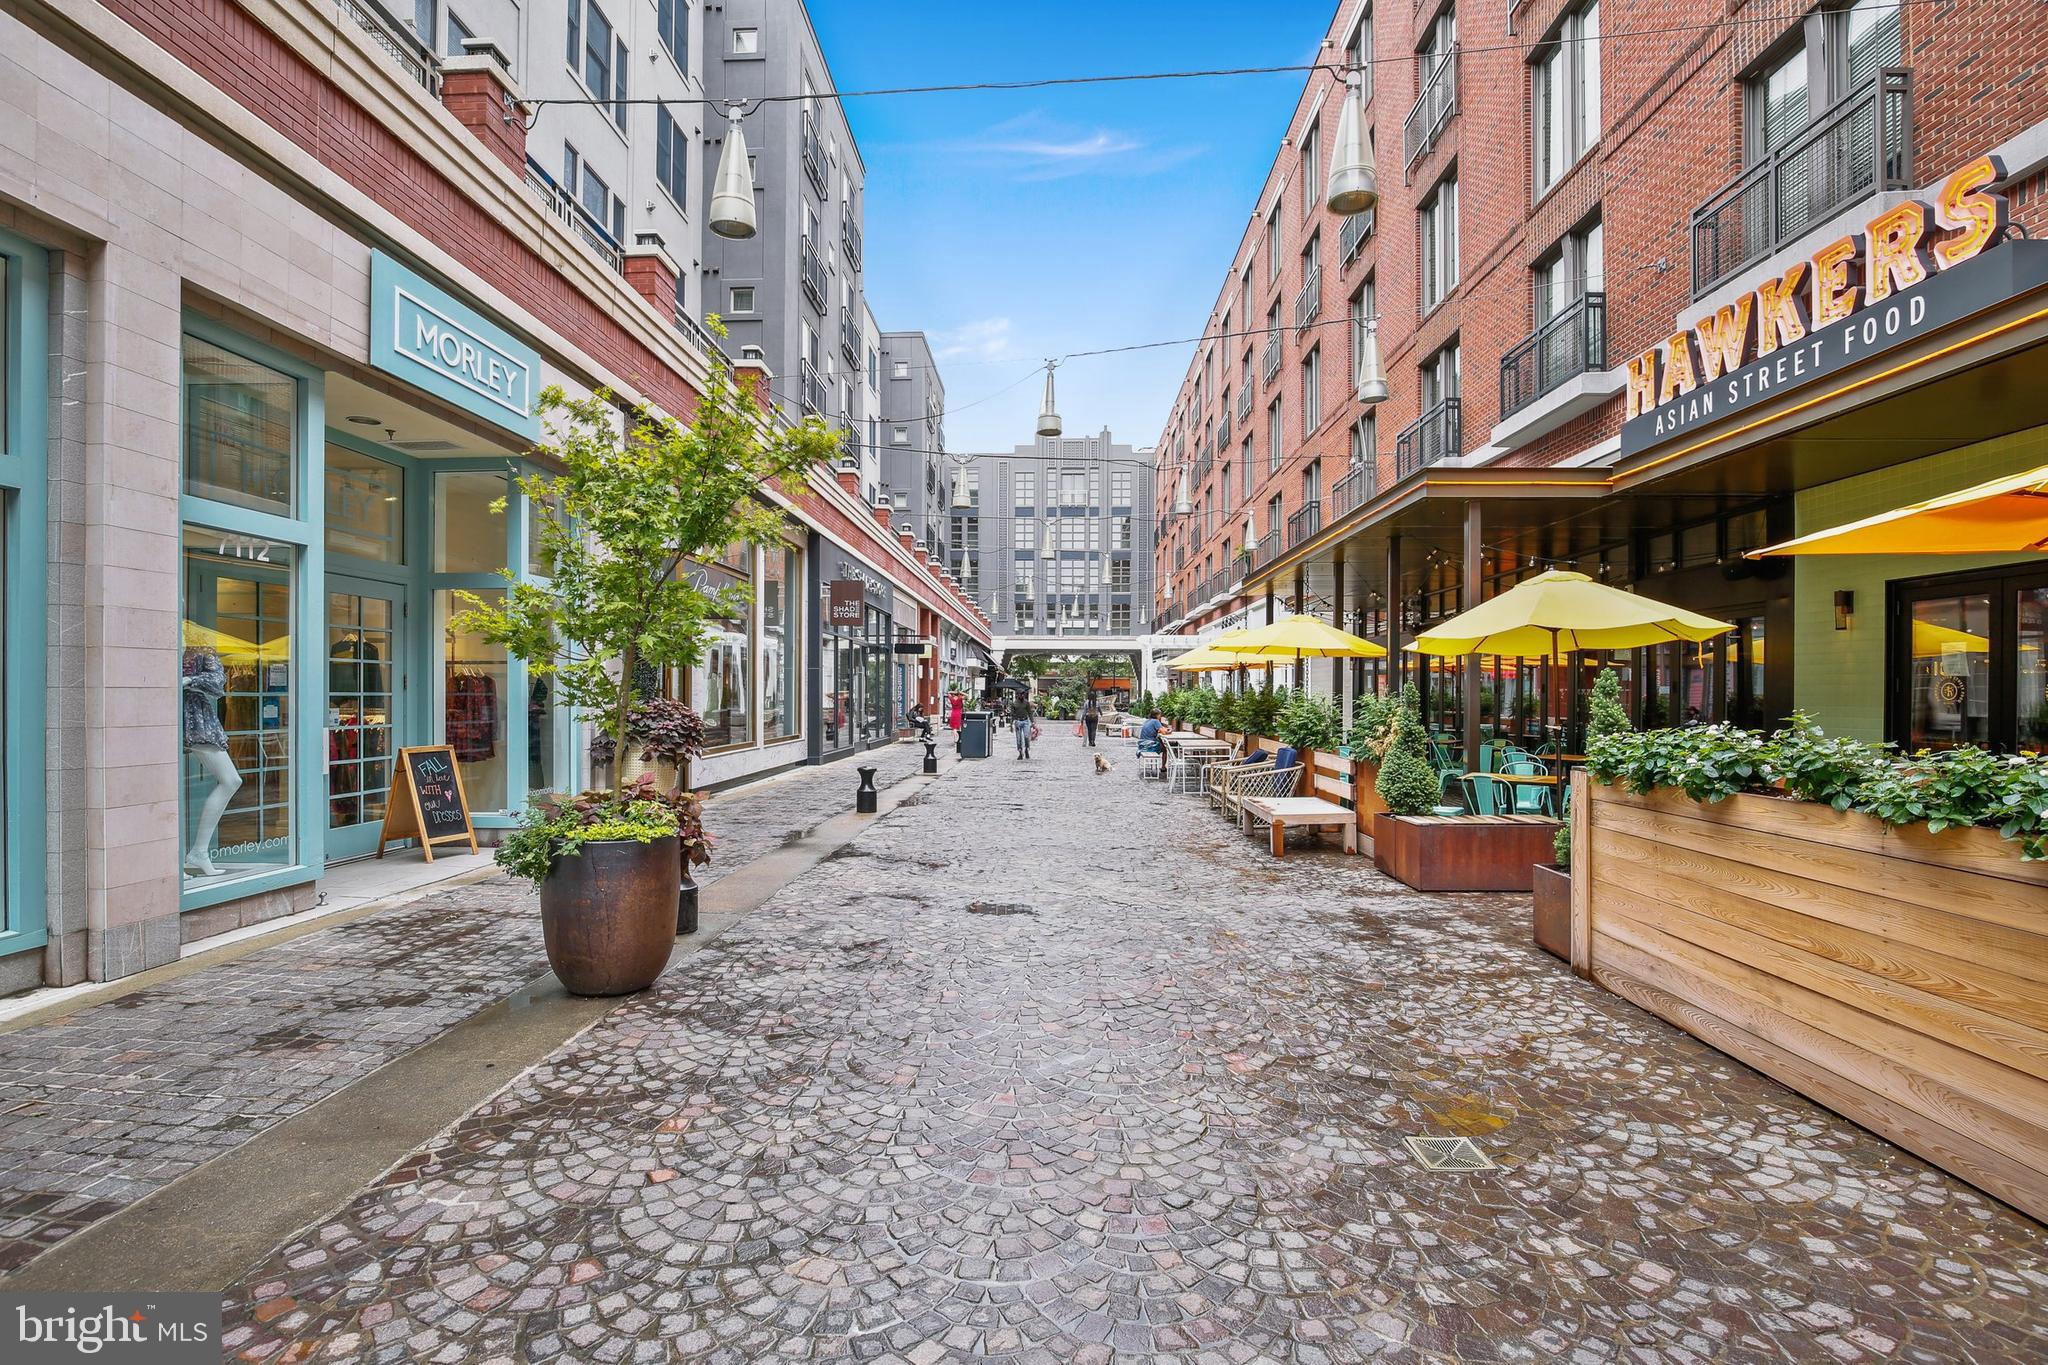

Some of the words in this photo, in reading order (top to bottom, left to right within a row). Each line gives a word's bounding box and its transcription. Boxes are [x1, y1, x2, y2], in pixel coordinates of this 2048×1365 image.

[1626, 154, 2007, 420] HAWKERS
[416, 313, 518, 399] MORLEY
[1655, 391, 1714, 436] ASIAN
[1728, 341, 1824, 405] STREET
[1844, 295, 1927, 355] FOOD
[418, 757, 448, 777] FALL
[419, 784, 442, 796] WITH
